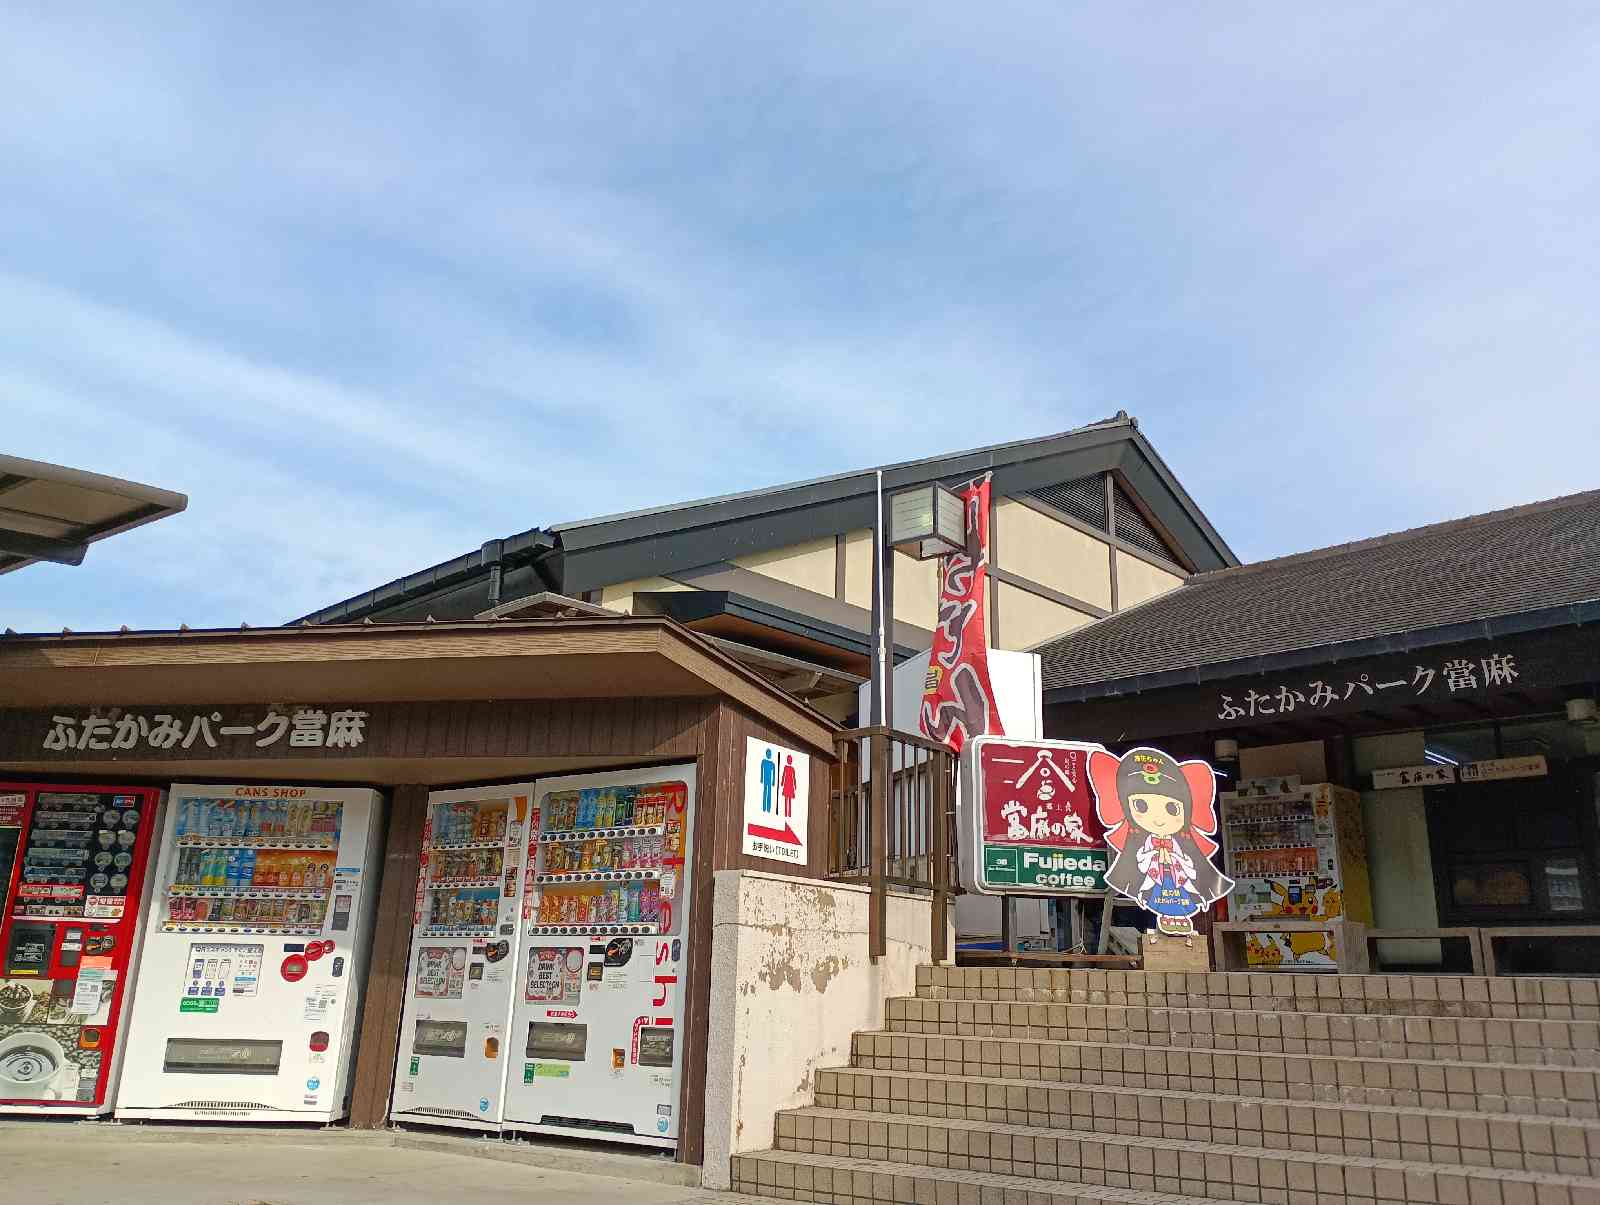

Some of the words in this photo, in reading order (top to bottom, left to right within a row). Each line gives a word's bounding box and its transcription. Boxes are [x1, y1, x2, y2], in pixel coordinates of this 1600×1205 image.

[1217, 653, 1520, 720] ふたかみパーク當麻
[42, 709, 370, 750] ふたかみパーク當麻
[272, 788, 306, 798] SHOP
[1023, 851, 1106, 872] Fujieda
[1035, 873, 1096, 887] coffee
